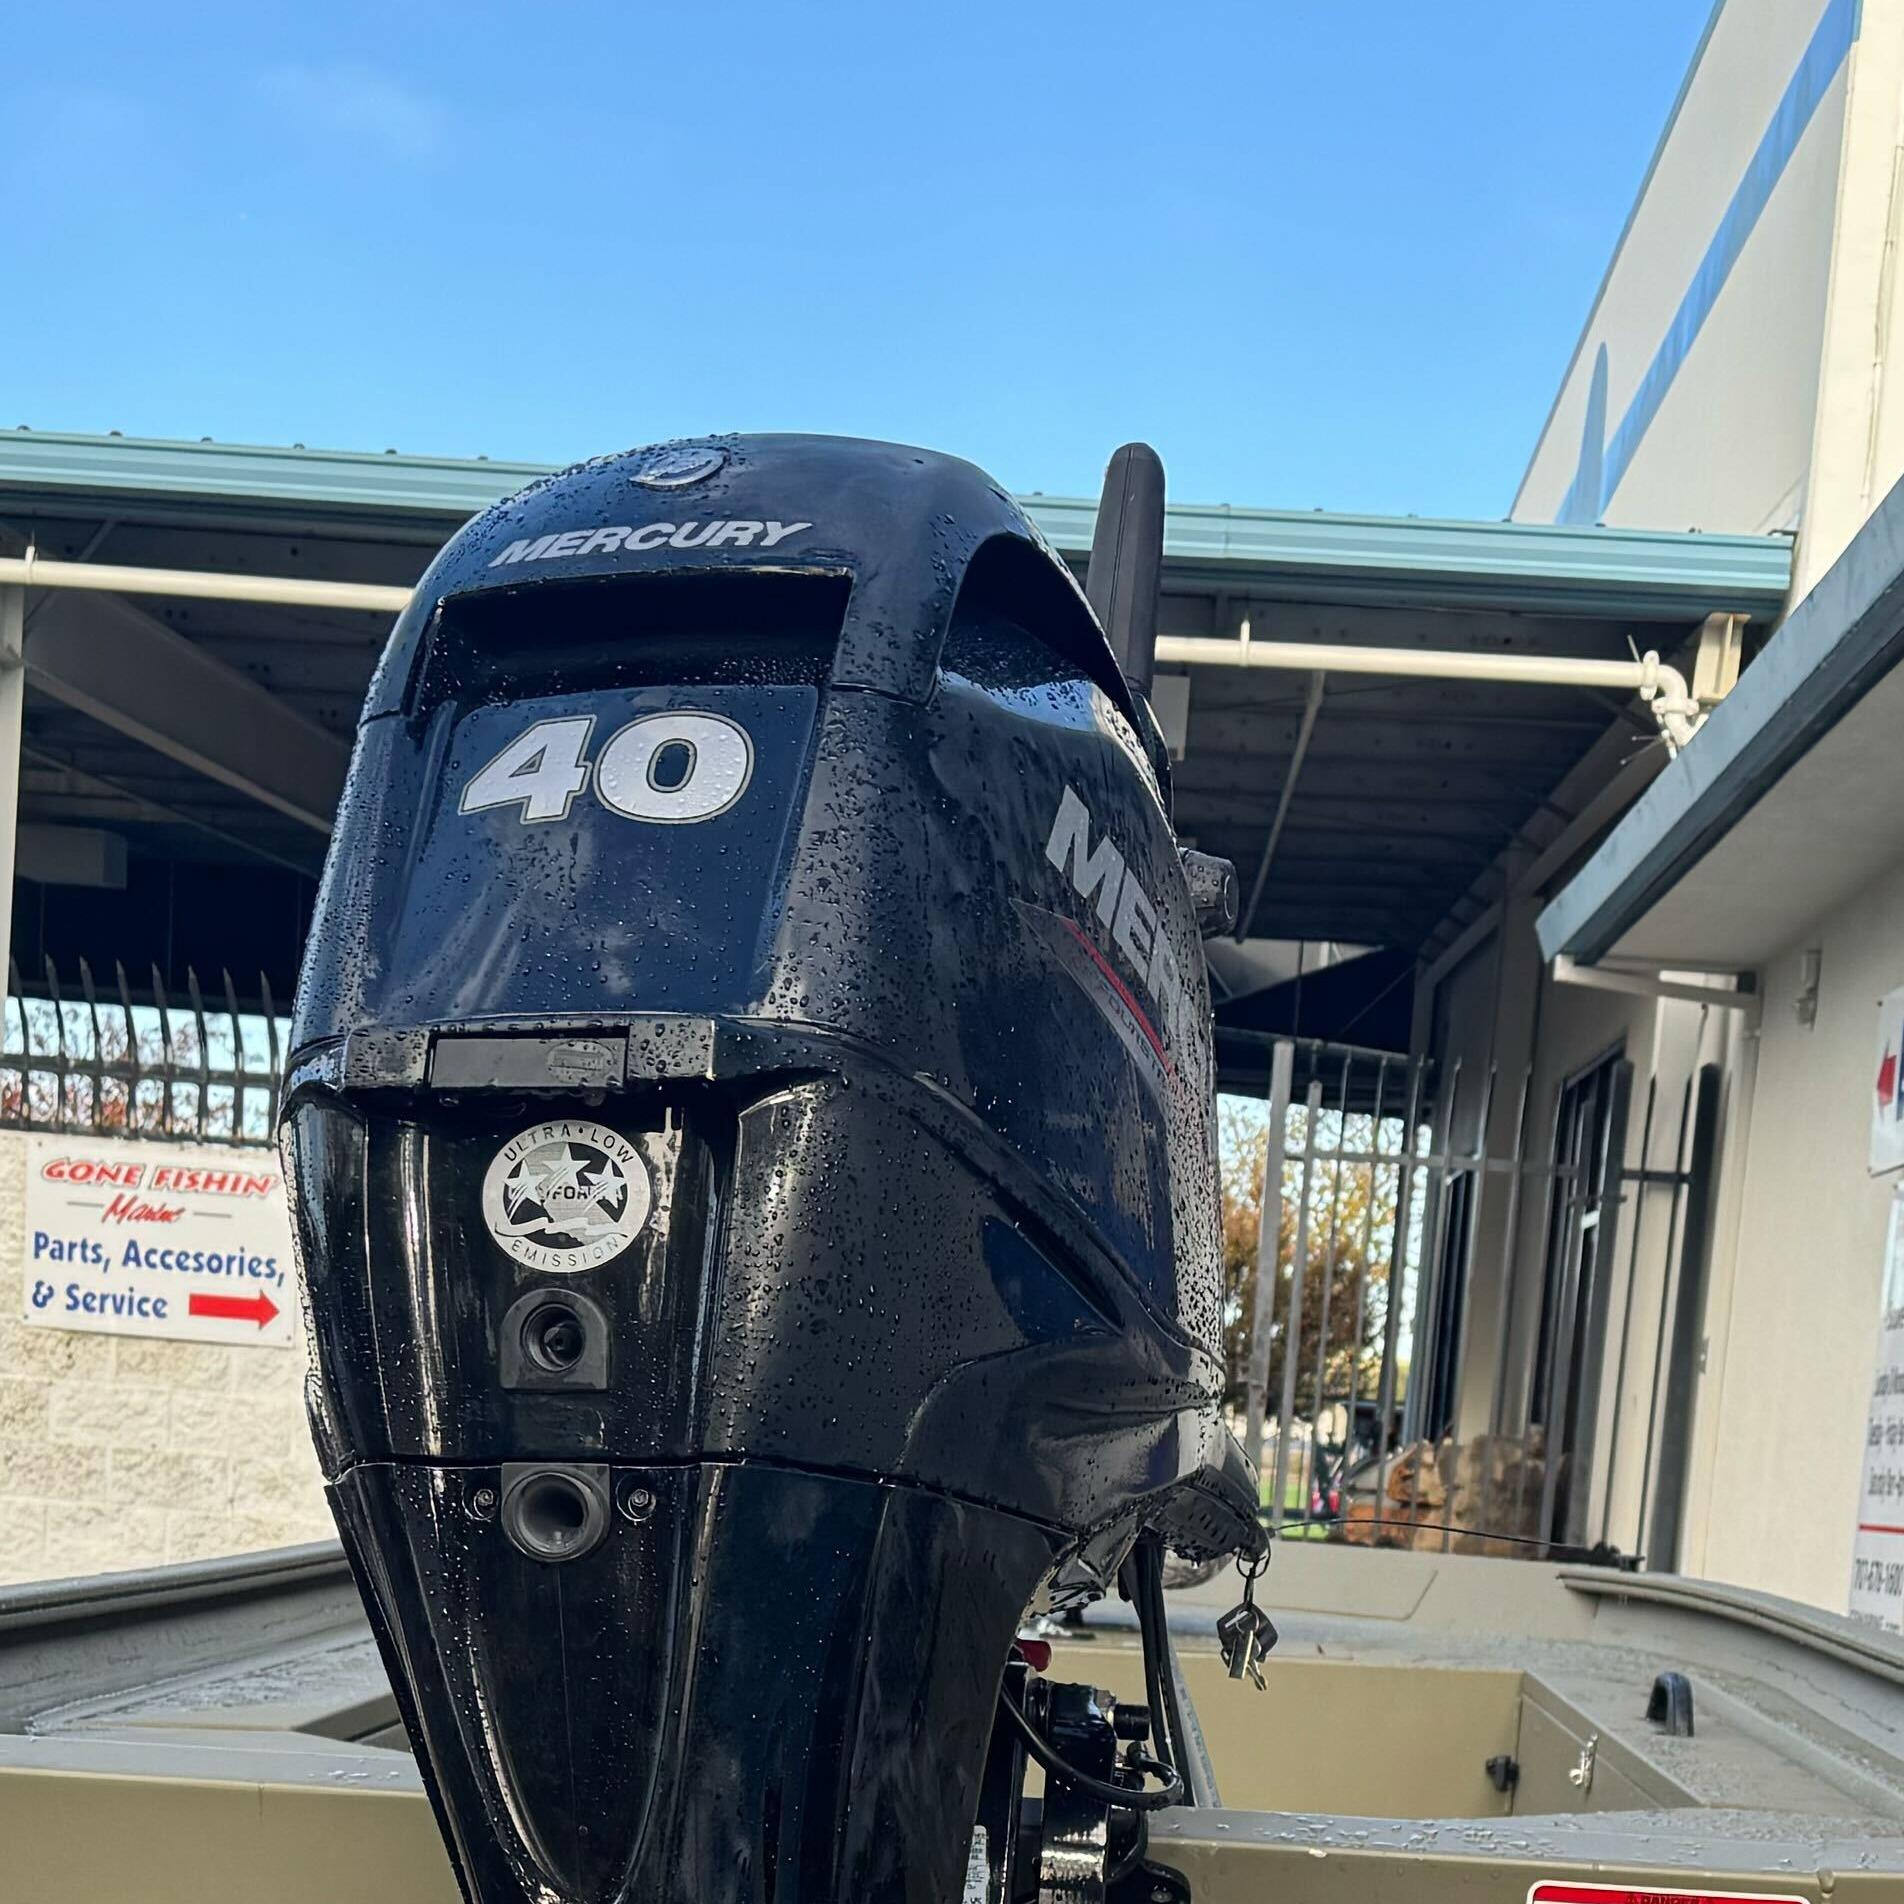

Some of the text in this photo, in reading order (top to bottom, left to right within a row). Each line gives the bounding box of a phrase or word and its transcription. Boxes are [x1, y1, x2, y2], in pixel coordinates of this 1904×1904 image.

[487, 519, 813, 568] MERCURY
[457, 709, 755, 825] 40
[42, 1157, 146, 1189] GONE
[100, 1193, 186, 1225] Marine
[33, 1231, 285, 1288] Parts, Accesories,
[32, 1280, 169, 1319] & Service
